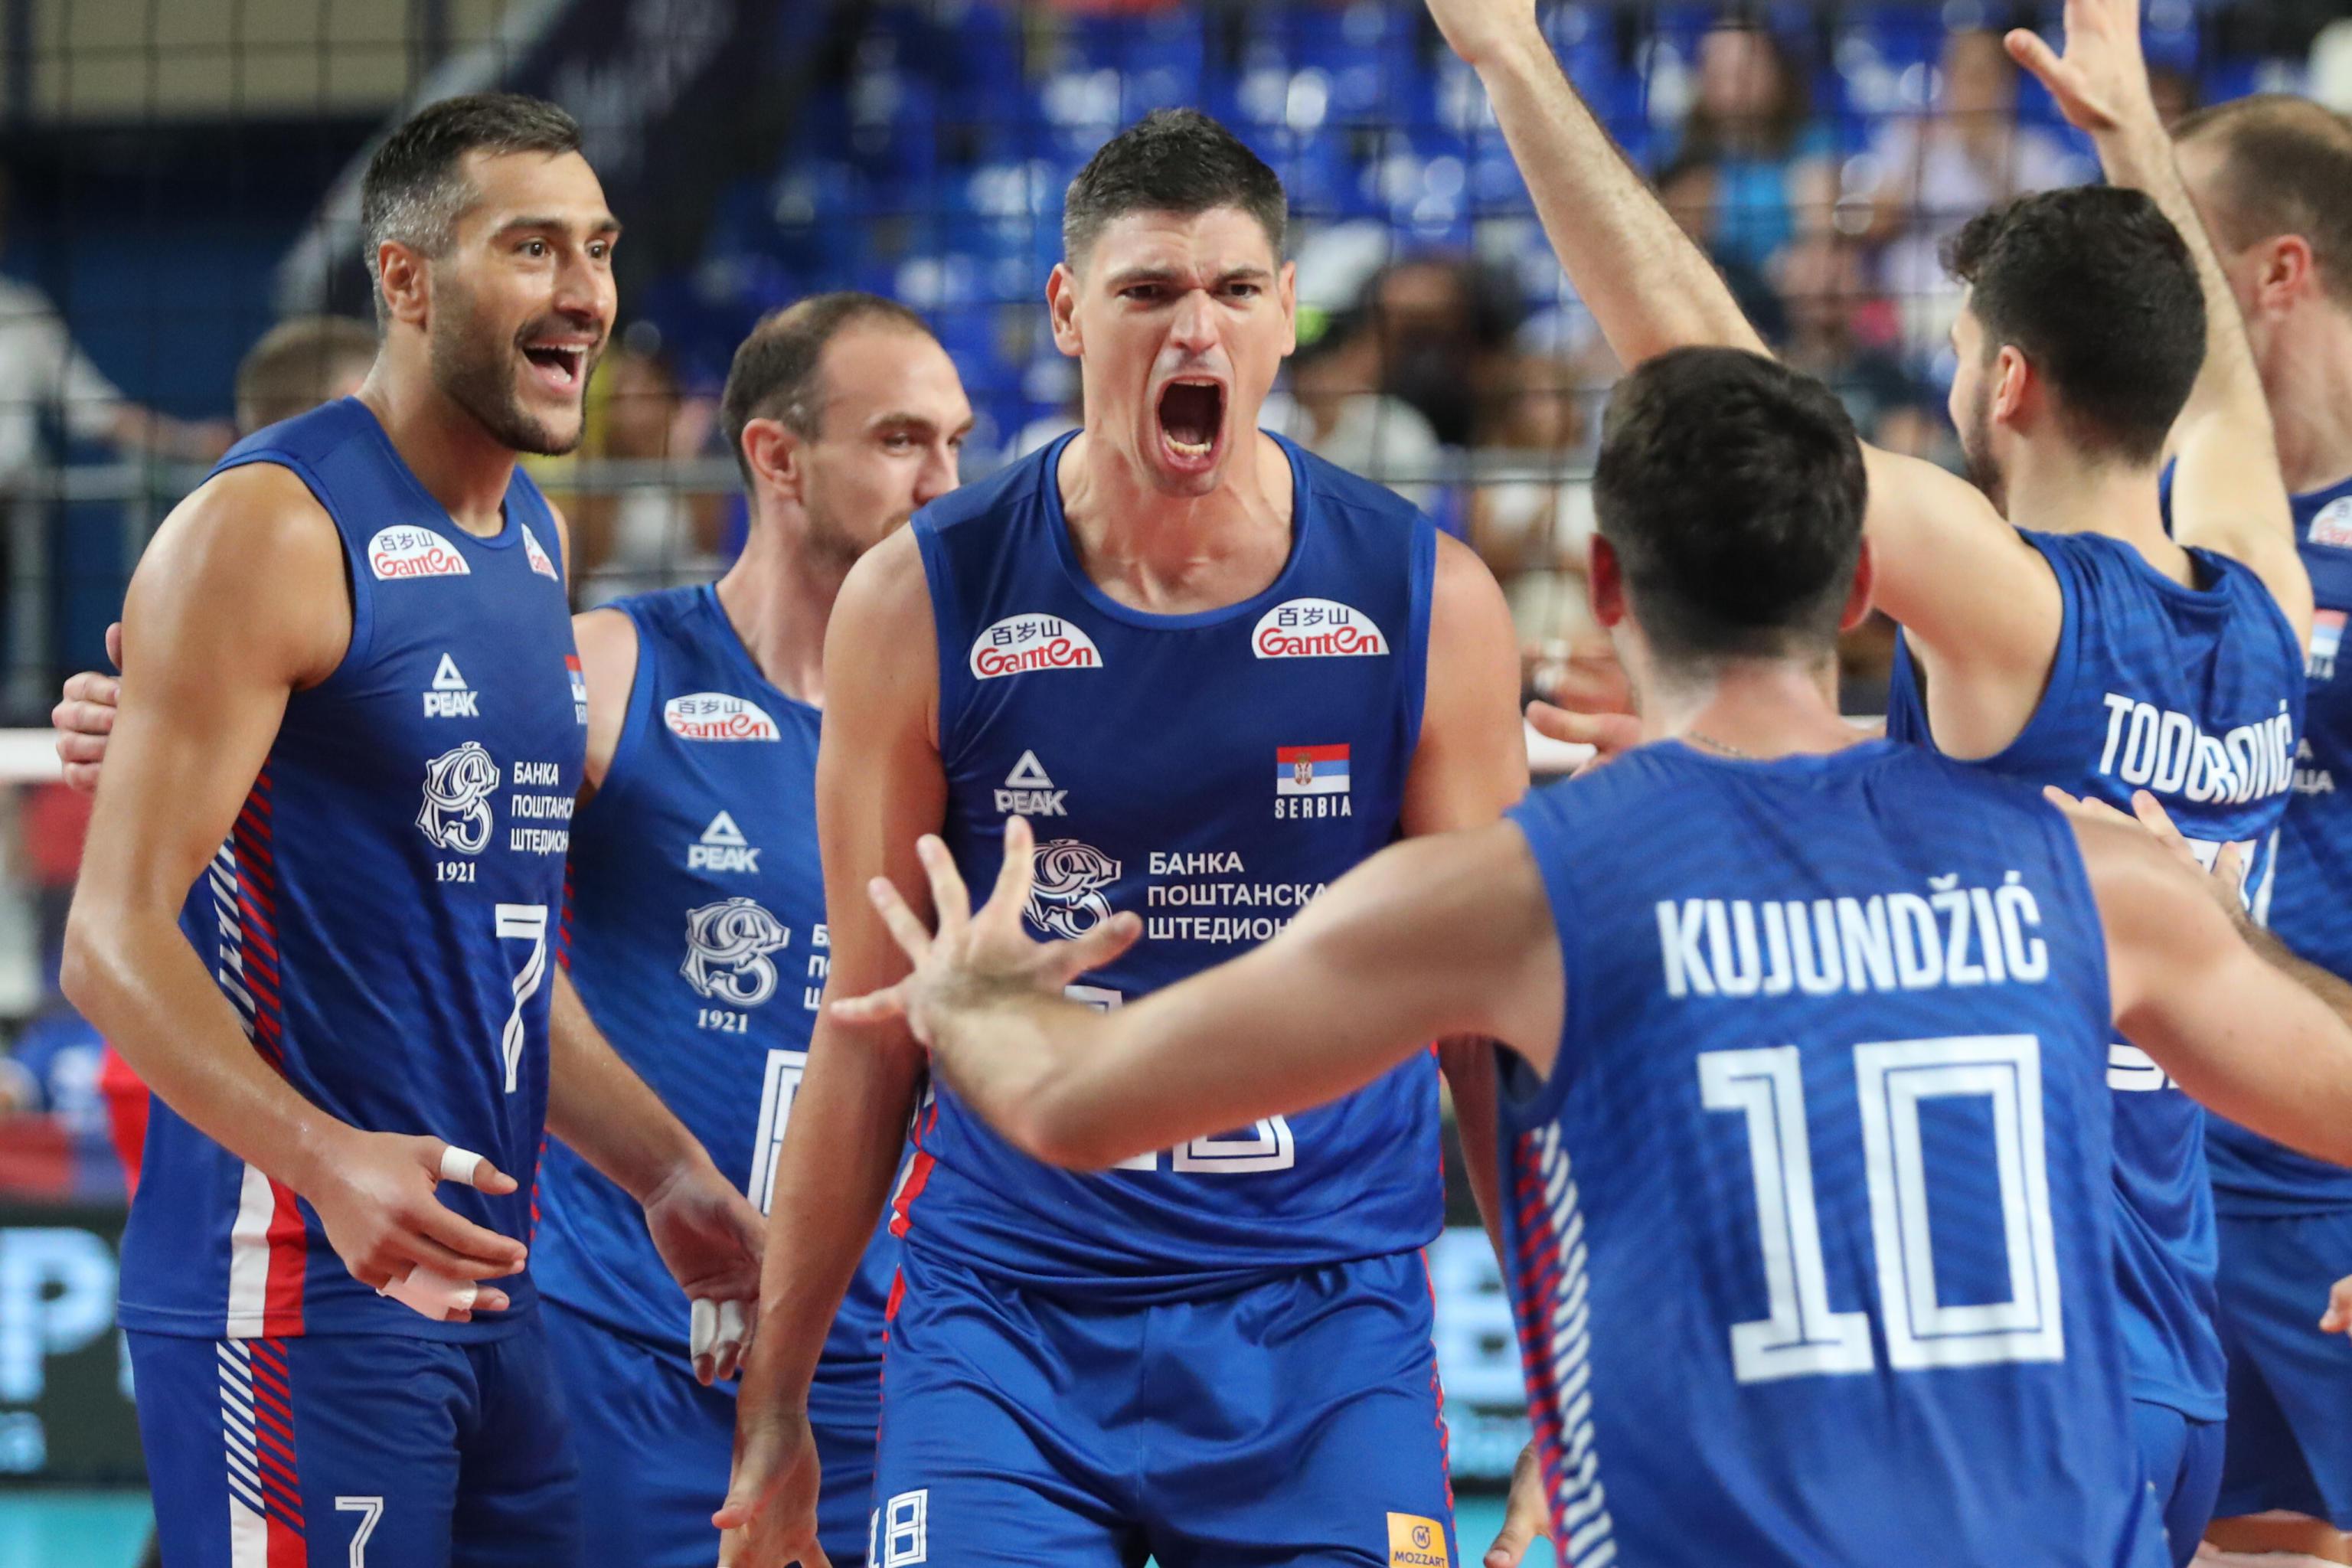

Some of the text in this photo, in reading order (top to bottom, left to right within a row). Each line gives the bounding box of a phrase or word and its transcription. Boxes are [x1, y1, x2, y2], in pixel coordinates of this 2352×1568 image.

[378, 531, 435, 552] 百岁山
[1278, 607, 1350, 626] 百岁山
[991, 619, 1063, 646] 百岁山
[1259, 626, 1379, 655] Ganten
[977, 638, 1093, 675] Ganten
[423, 691, 480, 718] PEAK
[678, 698, 743, 715] 百岁山
[513, 761, 559, 786] БАНКА
[994, 789, 1069, 817] PEAK
[1275, 795, 1352, 819] SERBIA
[435, 861, 476, 882] 1921
[687, 844, 761, 873] PEAK
[1148, 851, 1245, 876] БАНКА
[1656, 870, 2050, 998] KUJUNDŽIĆ
[495, 903, 548, 1093] 7
[697, 1008, 749, 1034] 1921
[1697, 1034, 2066, 1384] 10
[335, 1495, 384, 1568] 7
[1393, 1550, 1446, 1568] MOZZART
